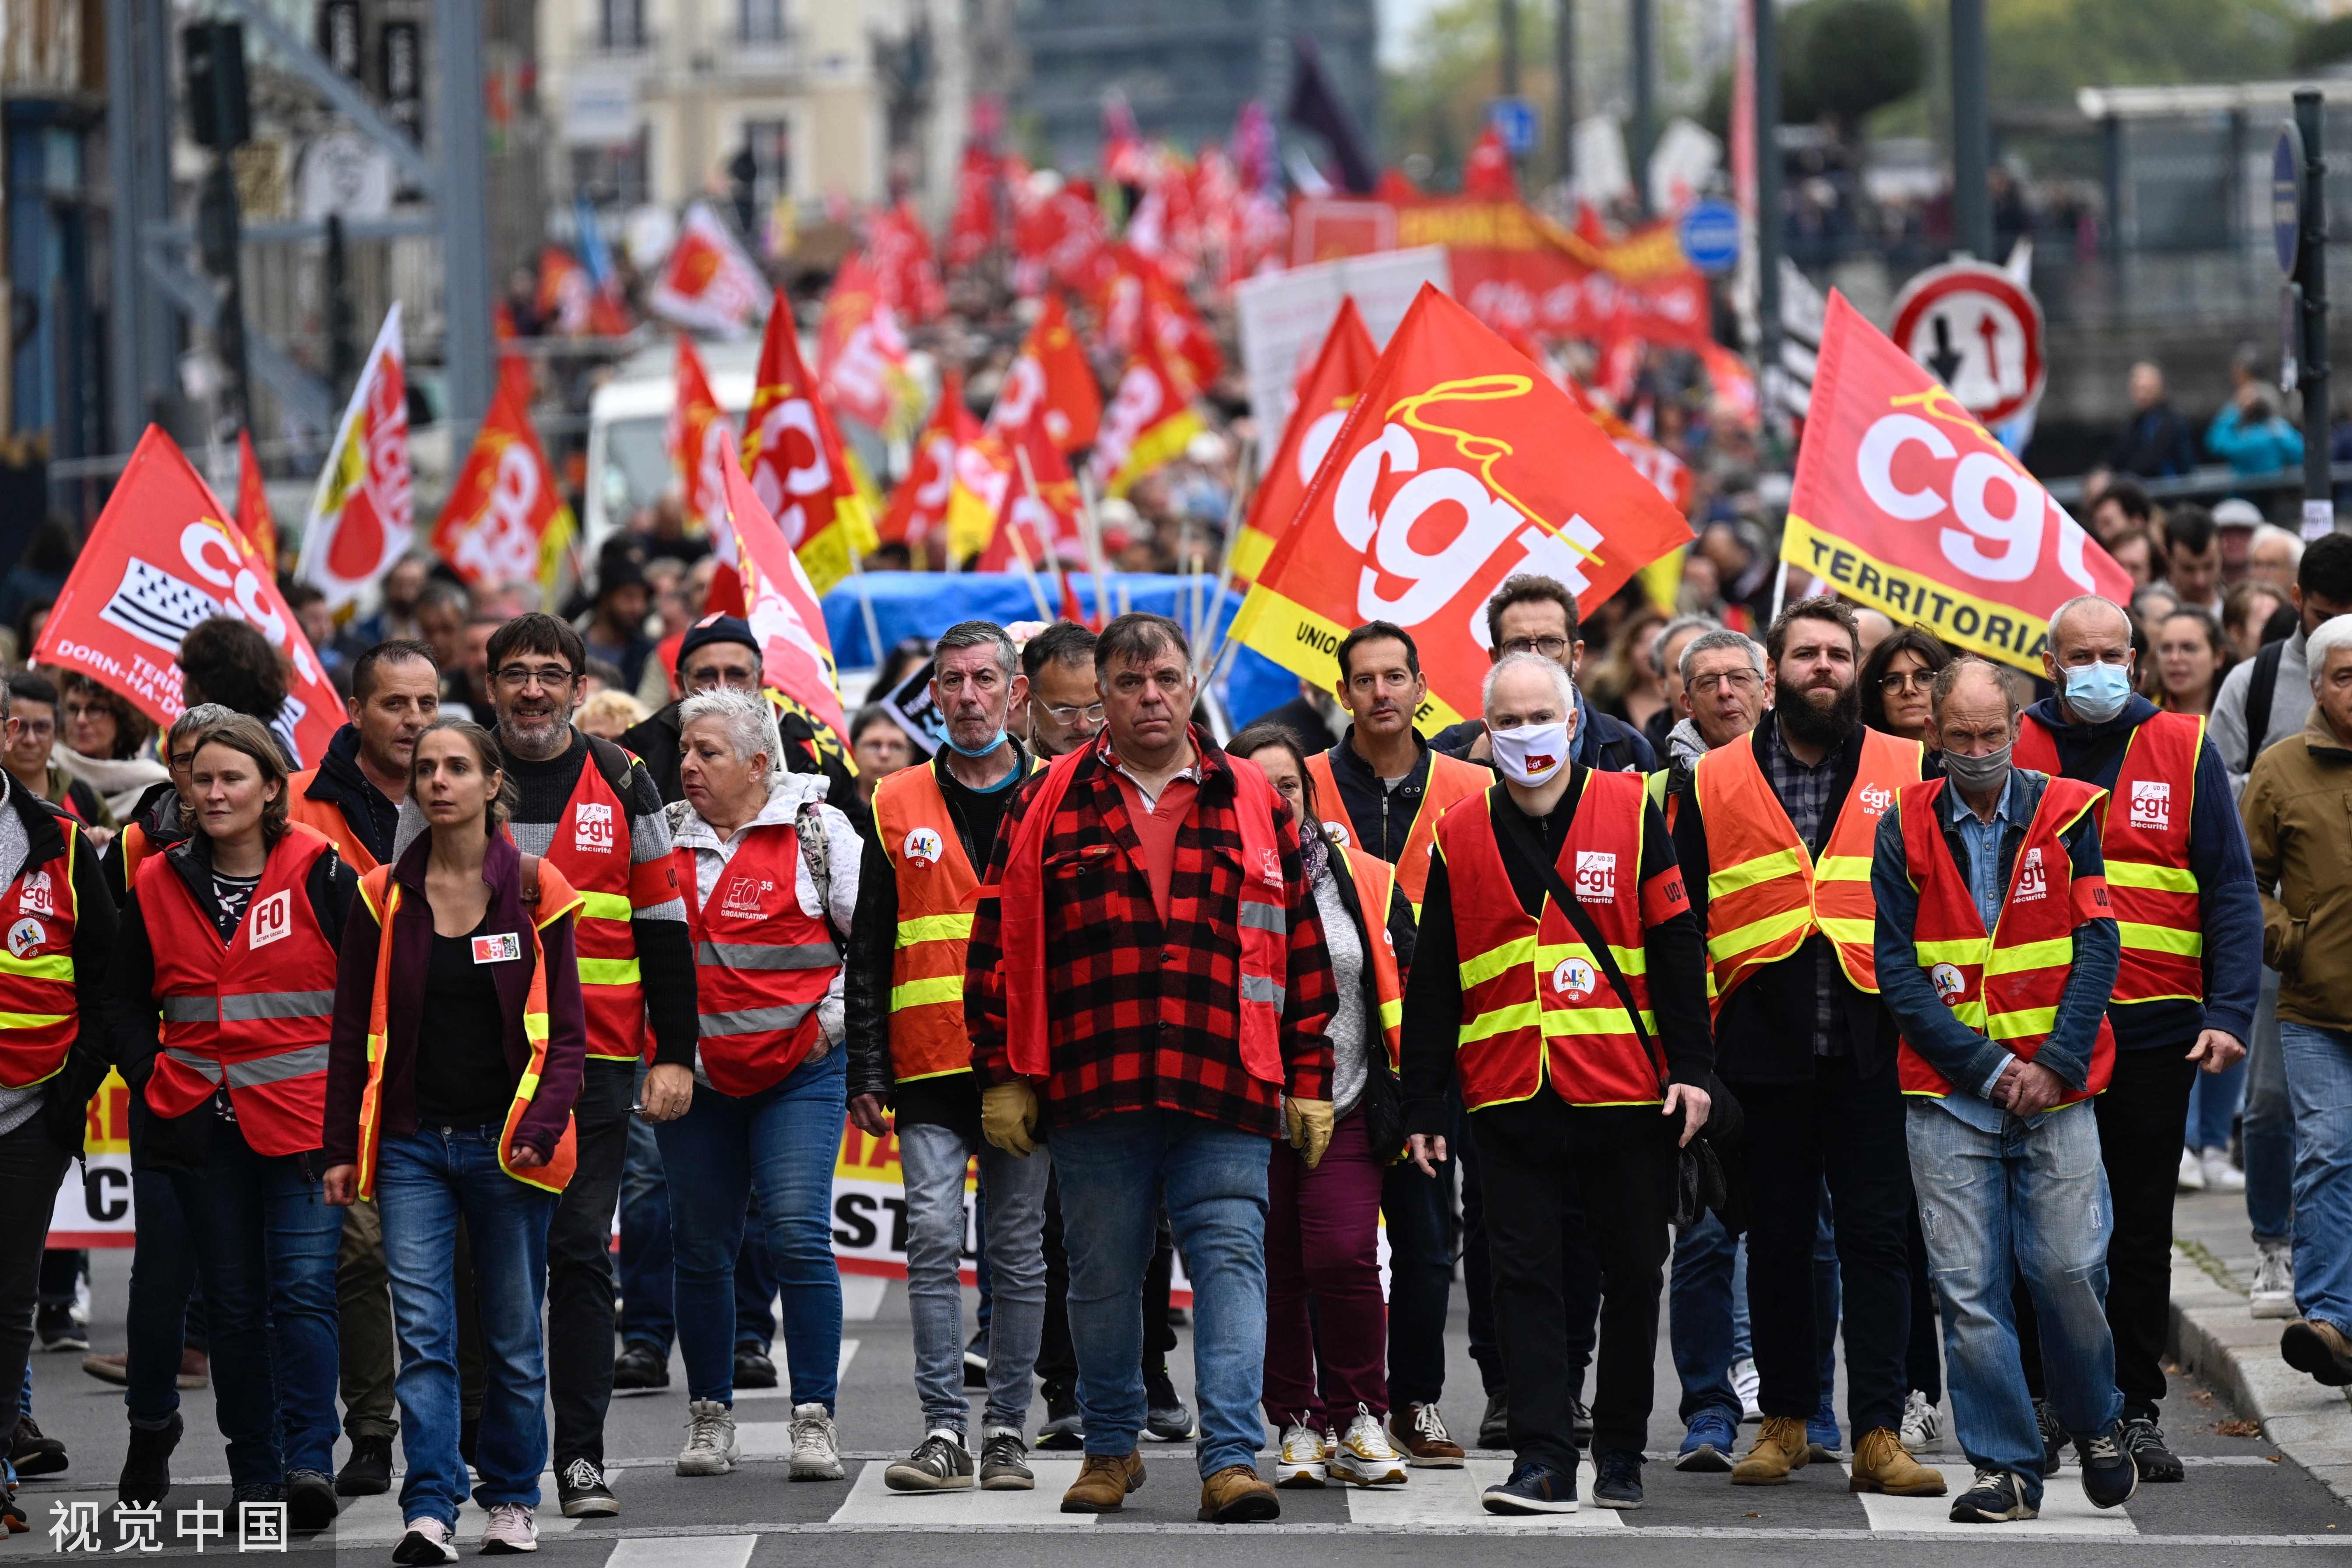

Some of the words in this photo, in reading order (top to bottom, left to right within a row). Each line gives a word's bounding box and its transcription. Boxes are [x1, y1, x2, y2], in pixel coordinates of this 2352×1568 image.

[1333, 423, 1604, 648] cgt
[1528, 760, 1541, 769] cgt
[1860, 789, 1891, 808] cgt
[2132, 796, 2170, 818] cgt
[576, 818, 613, 842] cgt
[2130, 821, 2168, 831] Sécurité
[576, 845, 612, 854] Sécurité
[1576, 867, 1615, 892] cgt
[2021, 862, 2045, 890] gt
[21, 888, 53, 909] cgt
[722, 877, 760, 910] FO
[760, 881, 773, 891] 35
[19, 908, 50, 922] Sécurité
[256, 899, 283, 935] FO
[721, 910, 768, 920] ORGANISATION
[270, 929, 284, 938] SOCIALE
[487, 938, 502, 959] cgt
